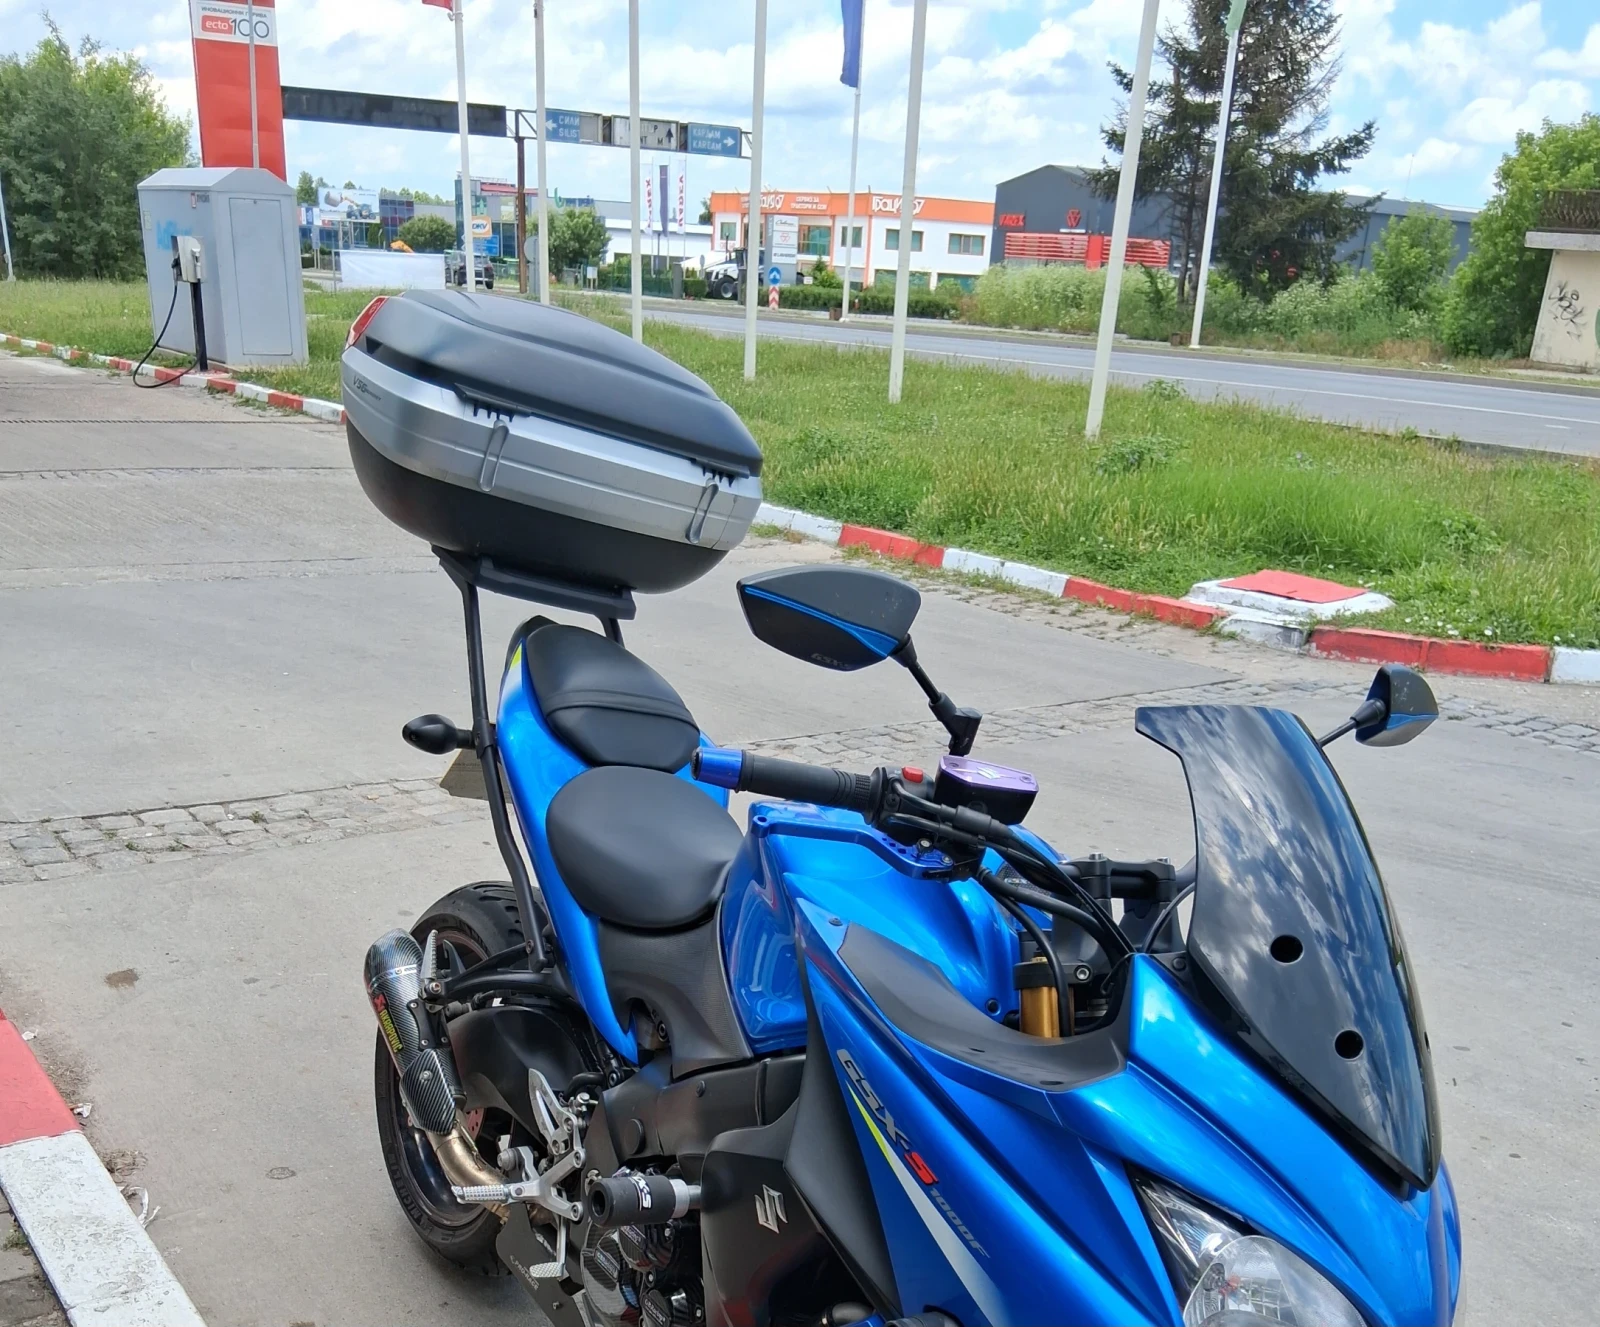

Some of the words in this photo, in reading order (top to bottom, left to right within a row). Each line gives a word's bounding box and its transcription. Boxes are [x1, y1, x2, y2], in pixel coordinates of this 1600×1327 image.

[245, 11, 267, 19] ГРИВА
[205, 19, 229, 30] ecto
[230, 18, 270, 39] 100
[472, 222, 488, 230] DKV
